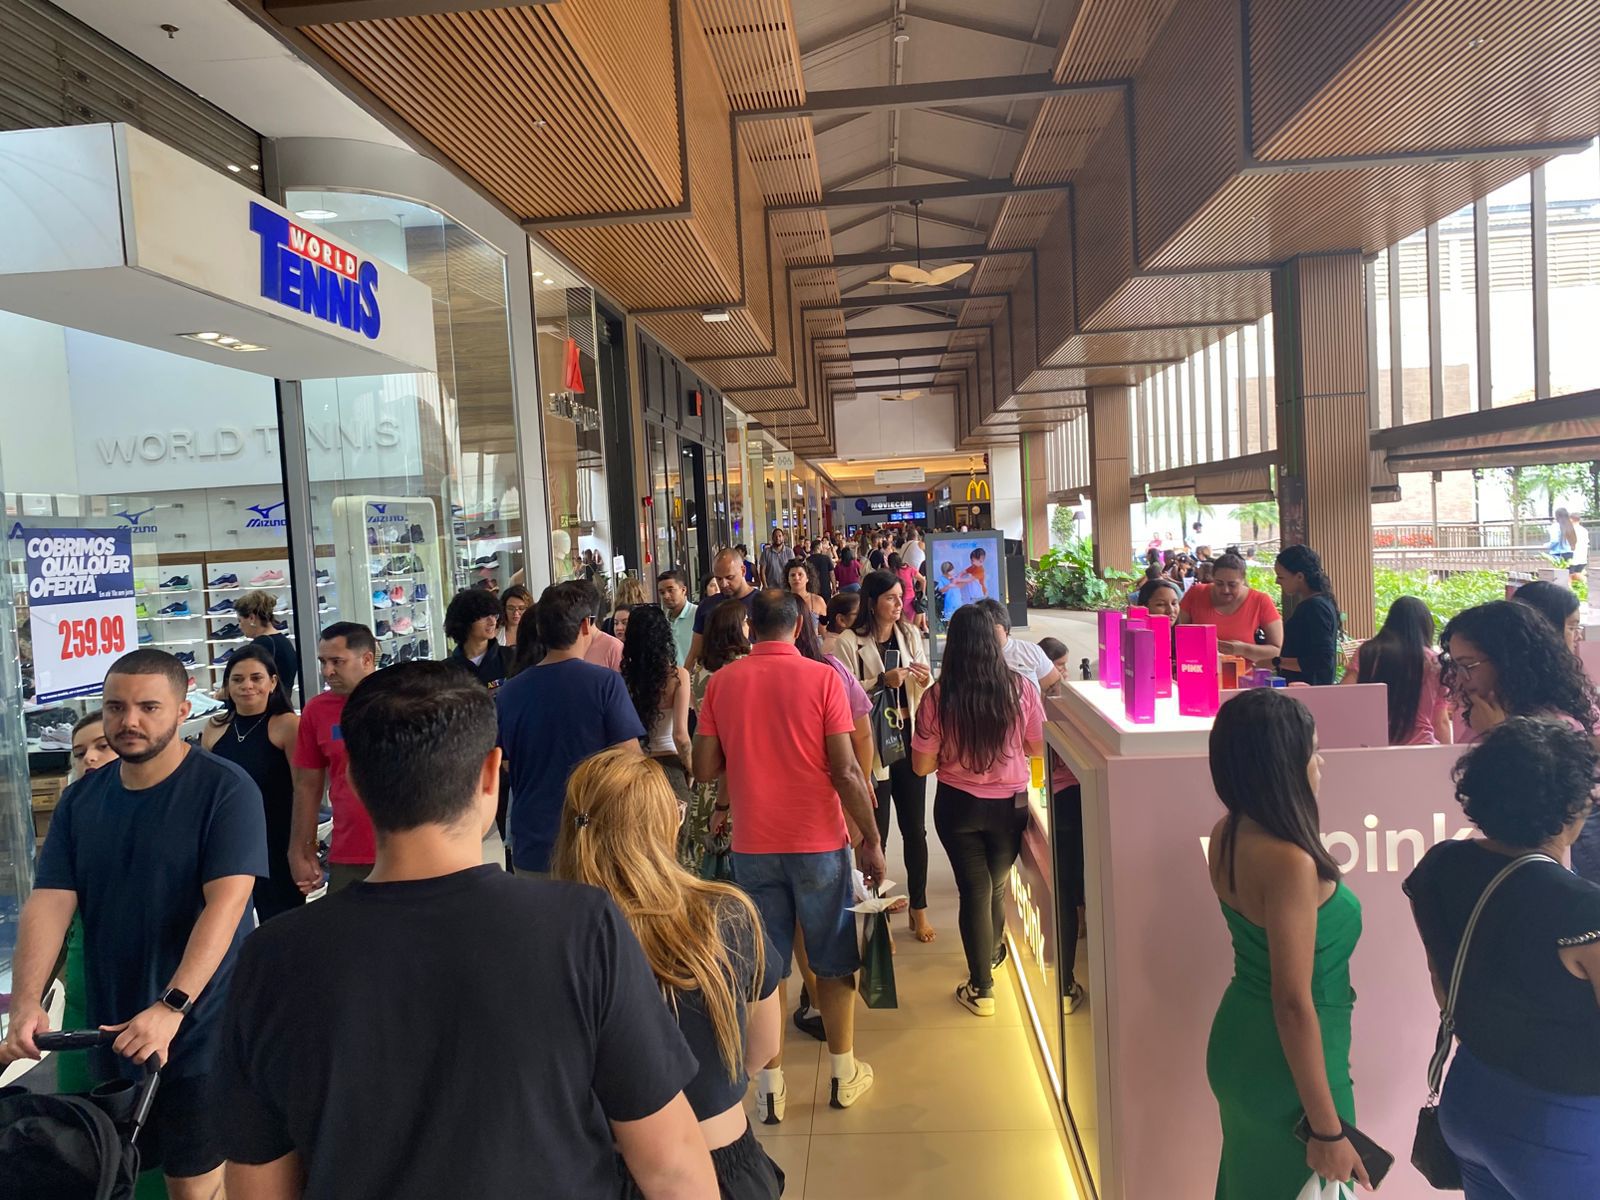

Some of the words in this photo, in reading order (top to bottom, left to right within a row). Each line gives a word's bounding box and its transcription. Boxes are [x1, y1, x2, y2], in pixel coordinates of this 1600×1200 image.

[289, 226, 356, 275] WORLD
[249, 201, 381, 340] TENNIS
[96, 427, 245, 465] WORLD
[254, 420, 400, 455] TNNIS
[870, 500, 913, 509] MOVIECOM
[27, 536, 116, 559] COBRIMOS
[41, 555, 131, 578] QUALQUER
[29, 575, 97, 599] OFERTA
[58, 615, 126, 661] 259,99
[1181, 663, 1203, 673] PINK
